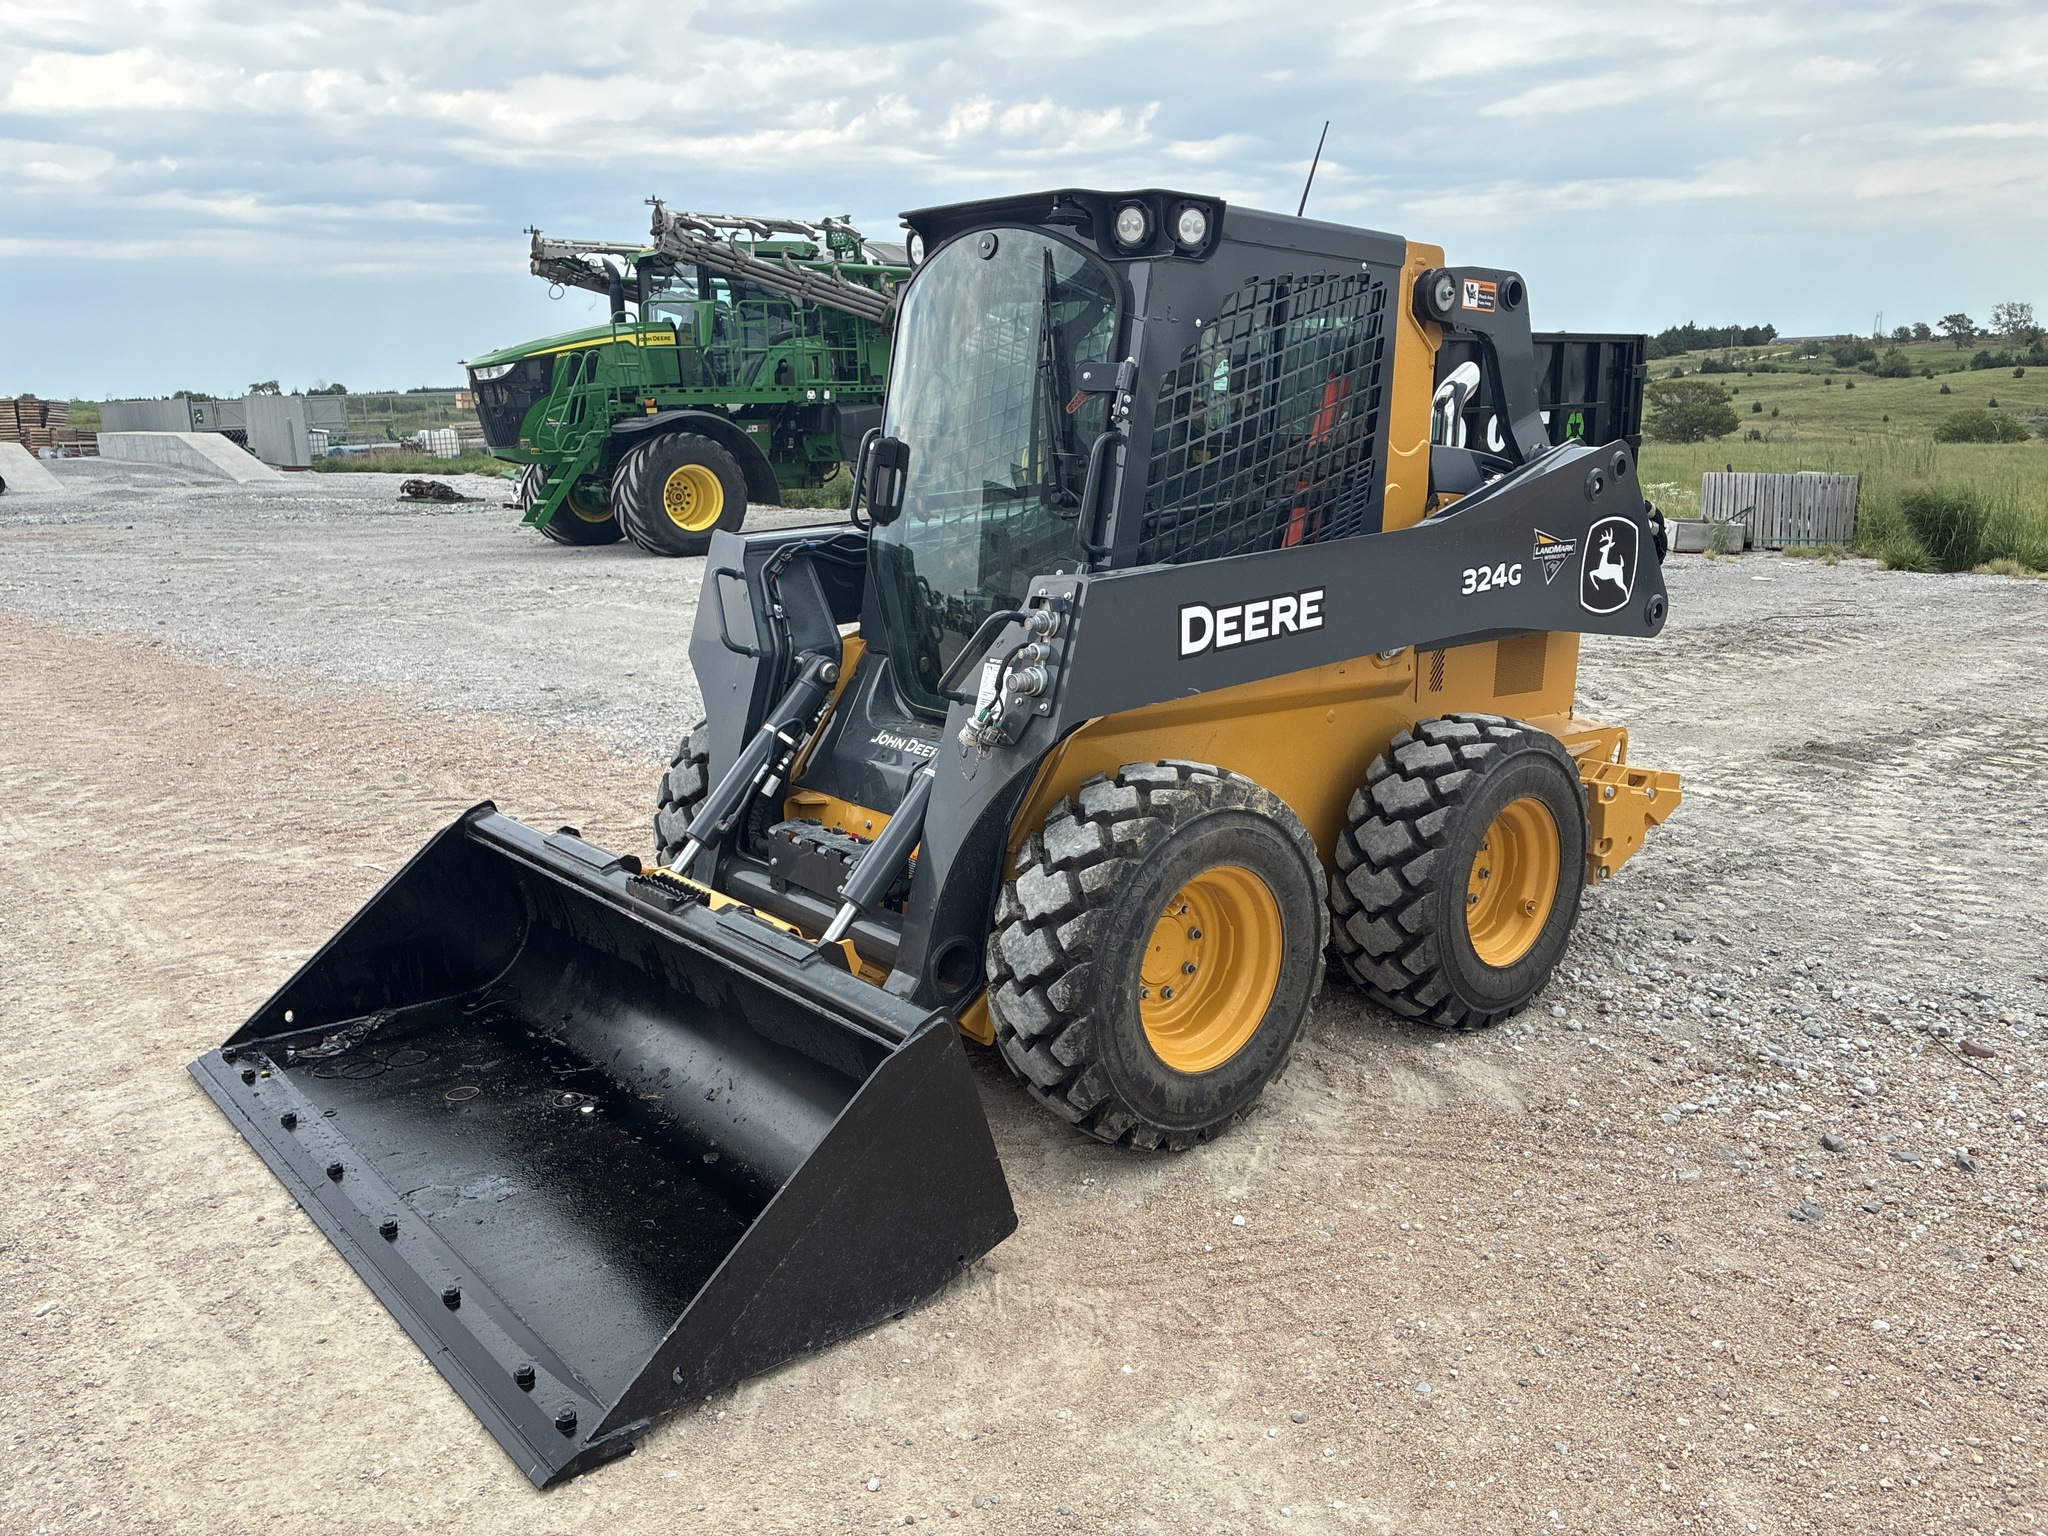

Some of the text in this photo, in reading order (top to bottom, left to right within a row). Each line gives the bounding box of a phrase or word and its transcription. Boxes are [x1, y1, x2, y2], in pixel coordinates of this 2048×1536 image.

[1535, 544, 1574, 555] LANDMARK
[1461, 562, 1522, 595] 324G
[1181, 589, 1324, 656] DEERE
[870, 730, 907, 750] JOHN
